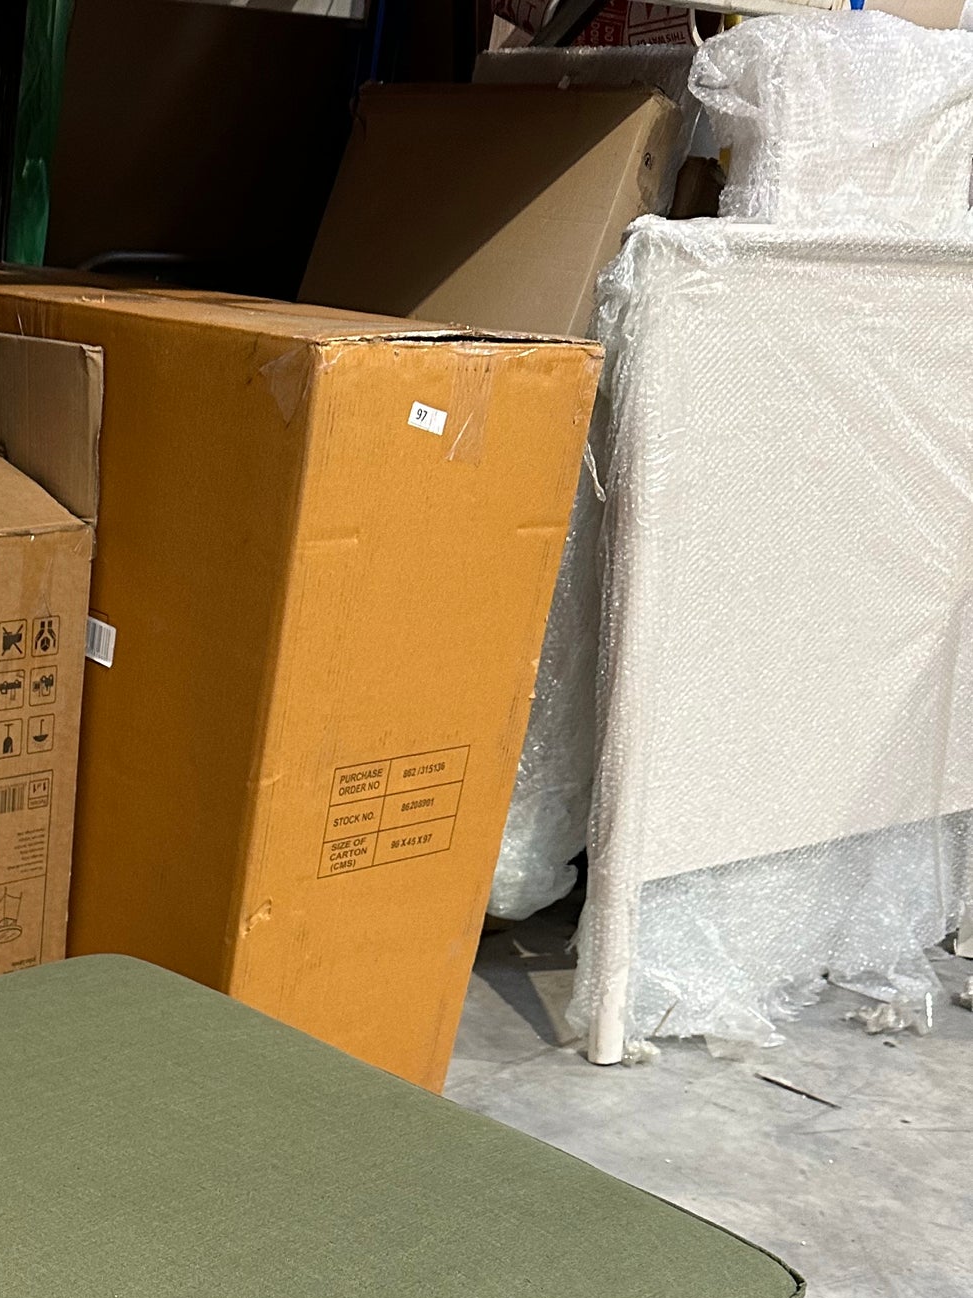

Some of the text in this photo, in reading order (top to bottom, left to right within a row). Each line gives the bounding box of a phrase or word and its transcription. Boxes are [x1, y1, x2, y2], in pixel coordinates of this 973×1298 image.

[666, 31, 686, 43] THIS
[416, 408, 428, 421] 97
[339, 768, 384, 785] PURCHASE
[338, 780, 381, 796] ORDER NO
[333, 813, 360, 827] STOCK
[331, 837, 367, 852] SIZE OF
[329, 847, 368, 861] CARTON
[330, 859, 357, 872] (CMS)
